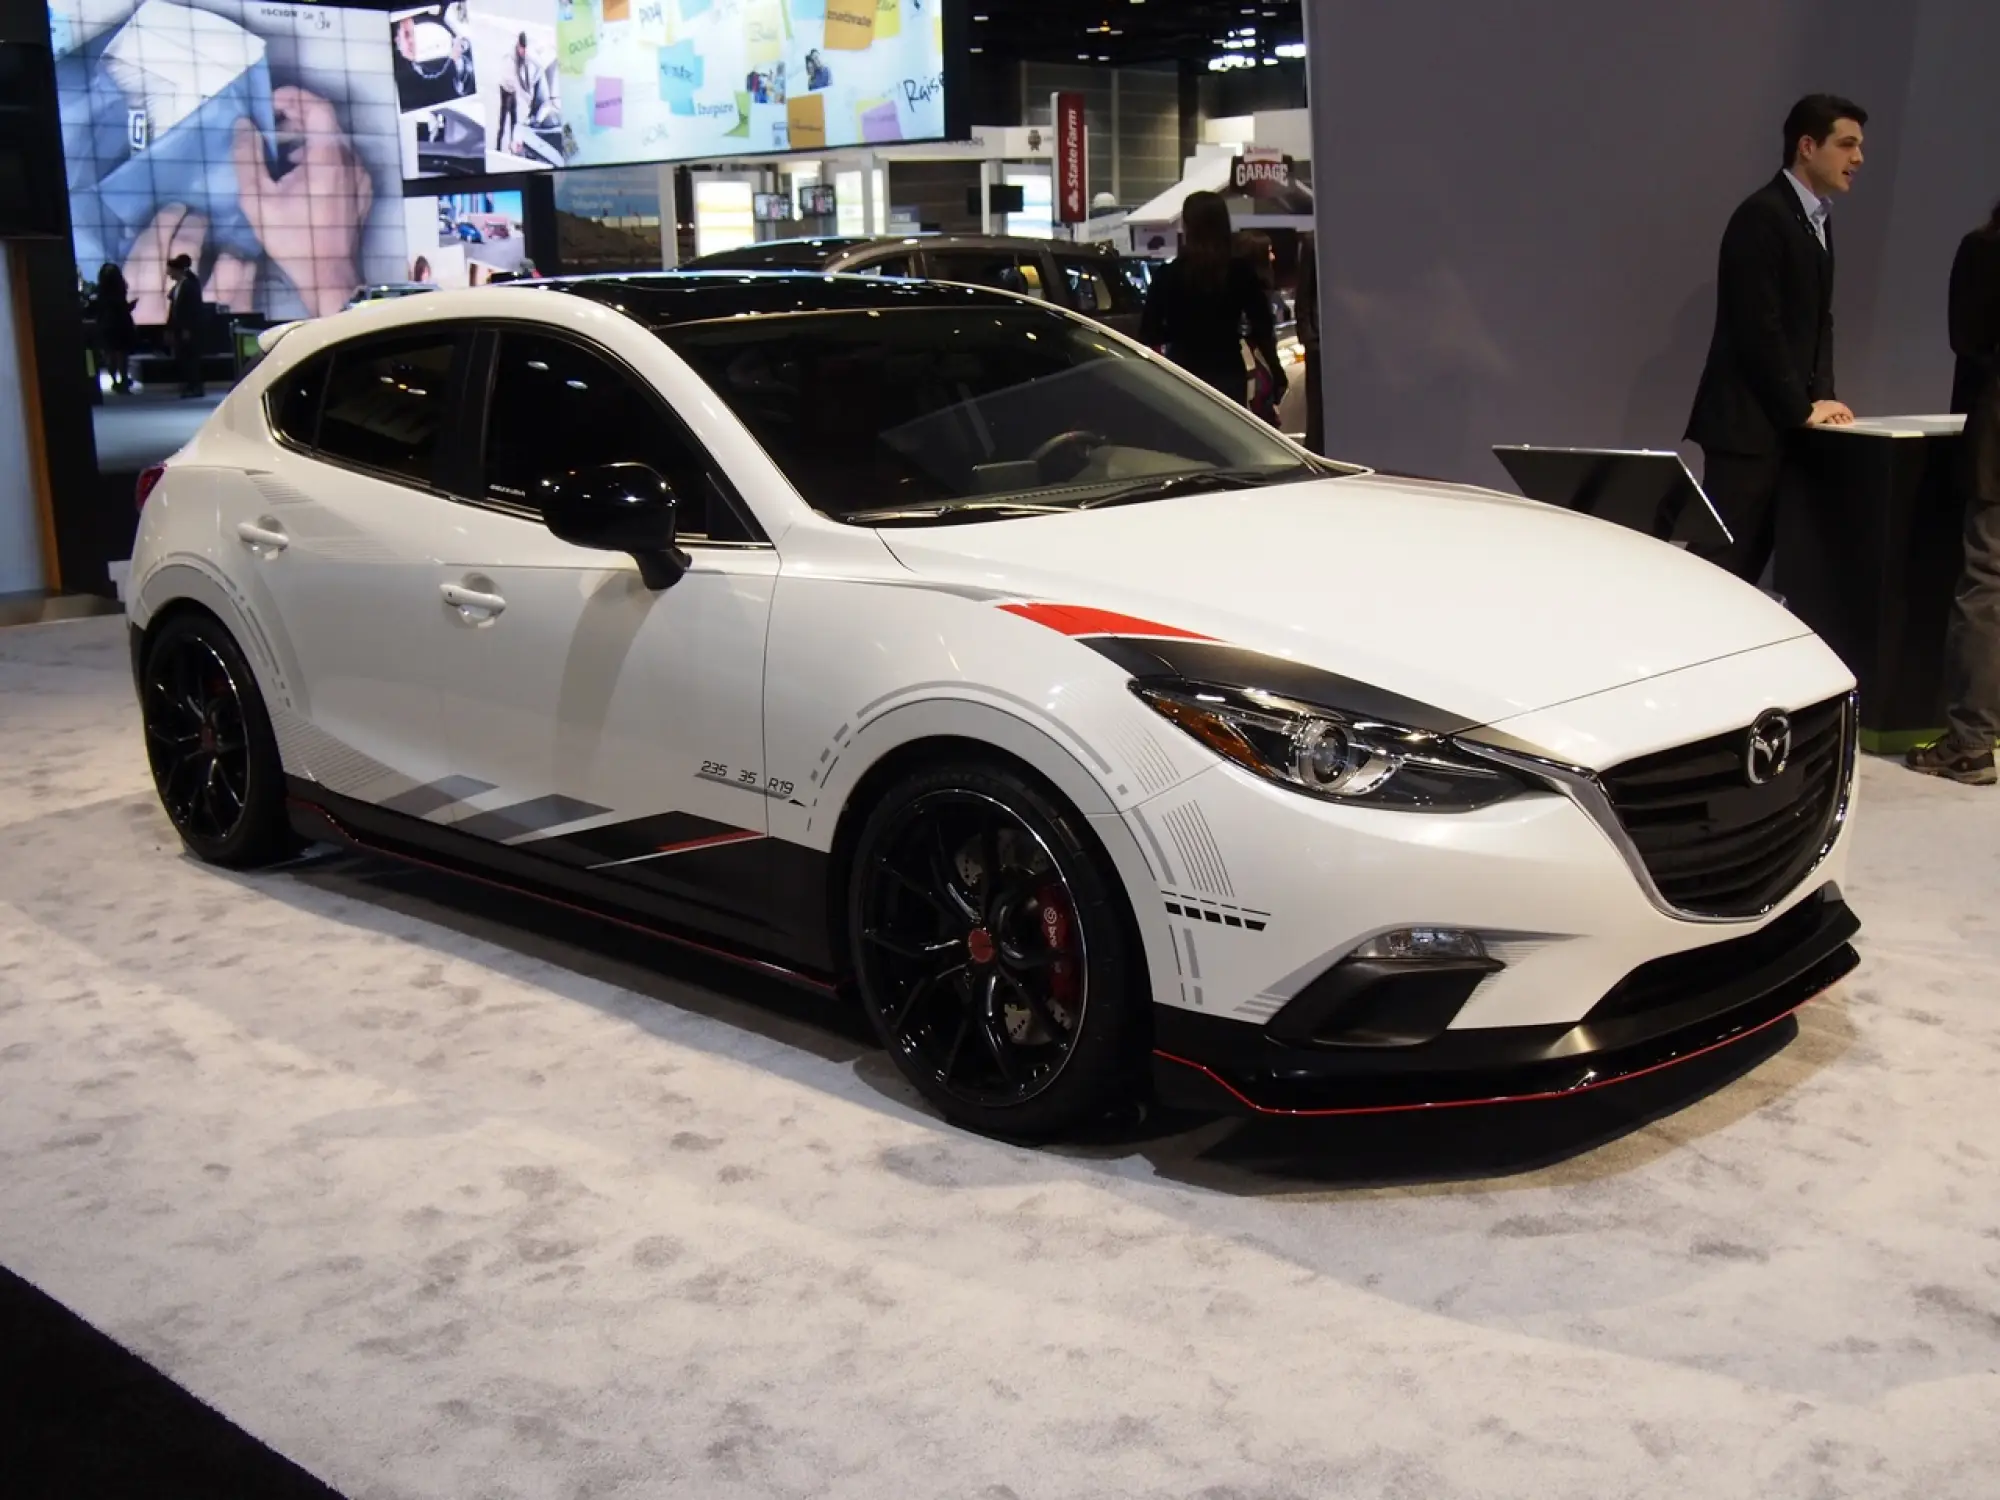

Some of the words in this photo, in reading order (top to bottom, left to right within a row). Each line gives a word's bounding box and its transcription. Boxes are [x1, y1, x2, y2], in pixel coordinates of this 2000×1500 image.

[1235, 163, 1289, 187] GARAGE
[701, 760, 728, 777] 235
[738, 769, 758, 784] 35
[768, 777, 794, 795] R19
